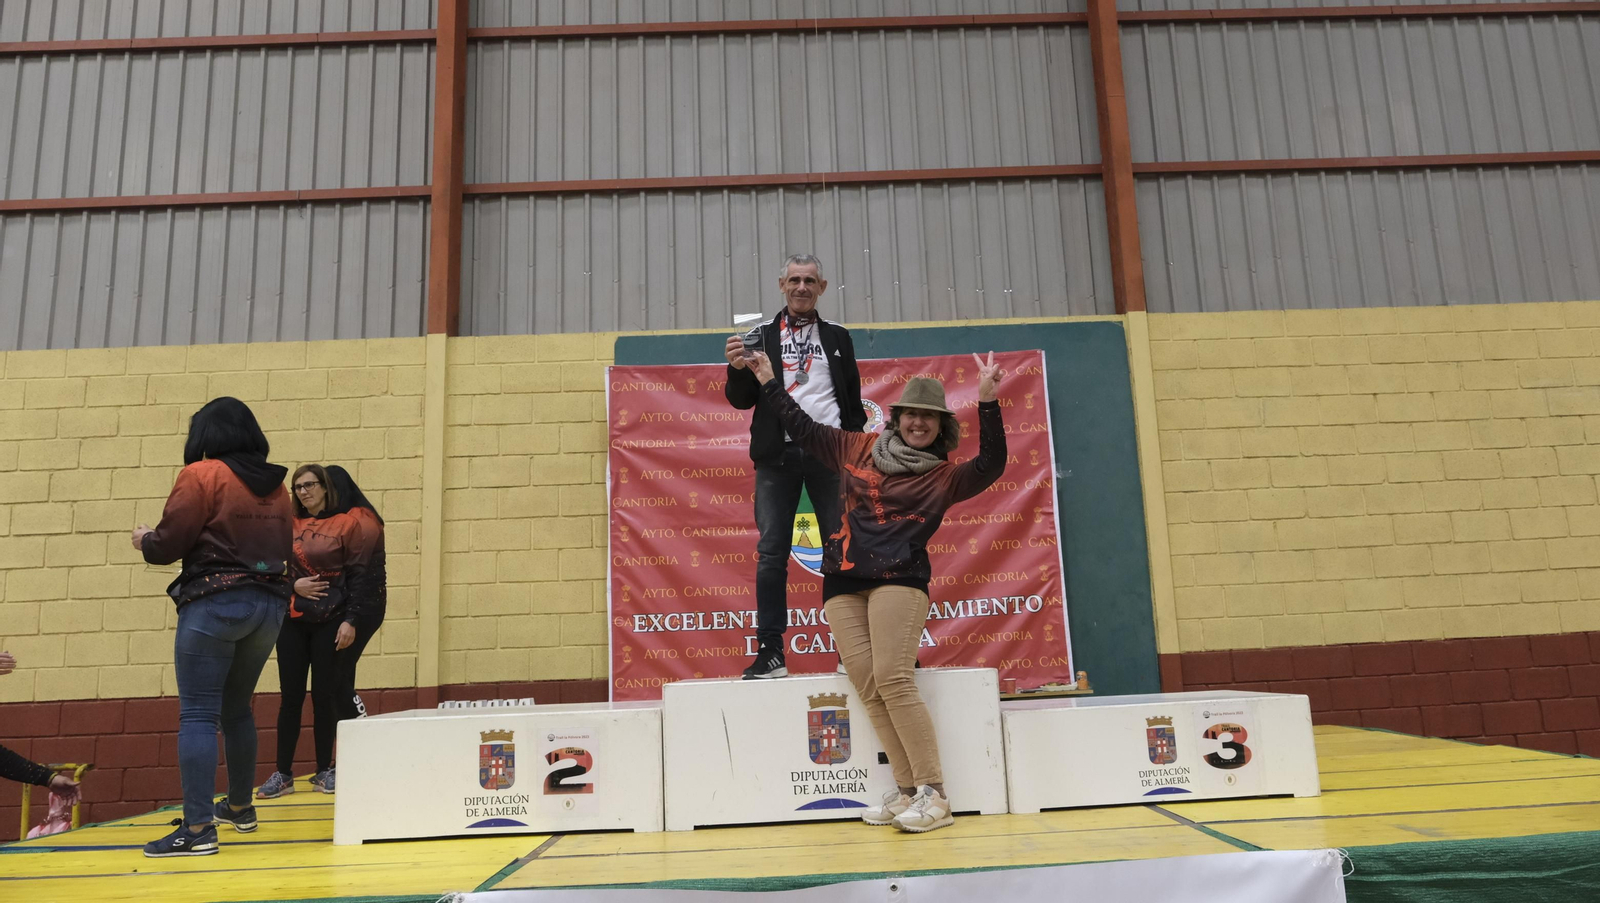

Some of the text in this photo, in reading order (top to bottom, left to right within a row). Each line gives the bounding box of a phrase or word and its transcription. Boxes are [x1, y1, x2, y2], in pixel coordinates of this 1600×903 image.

[611, 381, 676, 393] CANTORIA
[639, 411, 674, 423] AYTO.
[679, 410, 745, 422] CANTORIA
[611, 438, 676, 450] CANTORIA
[708, 437, 742, 447] AYTO.
[640, 466, 746, 480] AYTO. CANTORIA
[612, 494, 744, 508] CANTORIA AYTO.
[959, 513, 1024, 526] CANTORIA
[641, 526, 748, 539] AYTO. CANTORIA
[927, 543, 958, 554] ORIA
[990, 539, 1022, 551] AYTO.
[613, 553, 746, 567] CANTORIA AYTO.
[963, 571, 1029, 584] CANTORIA
[642, 587, 678, 599] AYTO.
[684, 585, 750, 597] CANTORIA
[925, 594, 1043, 620] AMIENTO
[935, 630, 1033, 646] YTO. CANTORIA
[644, 646, 746, 660] AYTO. CANTORI
[999, 659, 1033, 671] AYTO.
[1202, 722, 1252, 770] 3
[543, 746, 594, 795] 2
[790, 767, 868, 782] DIPUTACIÓN
[1138, 766, 1191, 778] DIPUTACIÓN
[793, 780, 867, 795] DE ALMERÍA
[1141, 775, 1191, 787] DE ALMERÍA
[464, 793, 530, 806] DIPUTACIÓN
[466, 805, 528, 818] DE ALMERÍA
